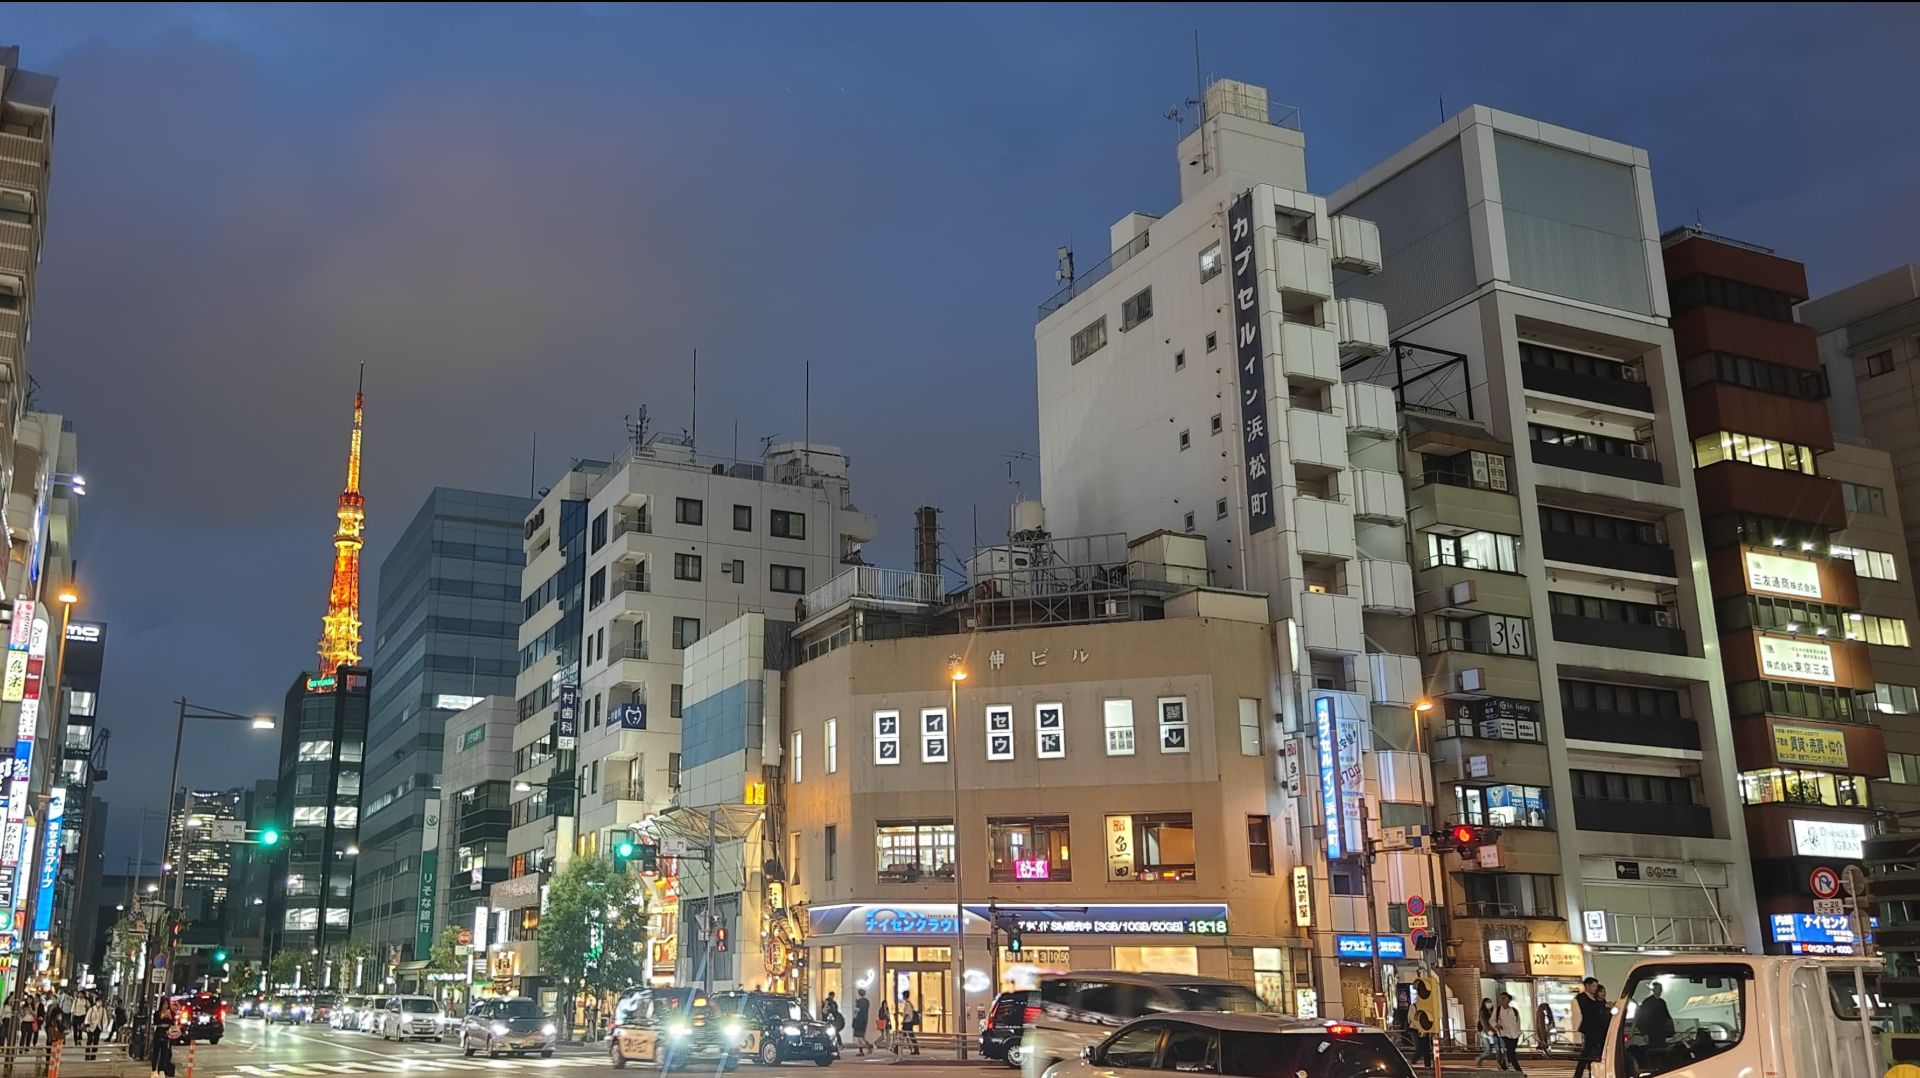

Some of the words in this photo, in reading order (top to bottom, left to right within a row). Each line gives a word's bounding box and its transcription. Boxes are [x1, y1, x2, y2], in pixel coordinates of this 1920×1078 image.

[1232, 217, 1268, 516] カプセルイン浜松町
[560, 738, 573, 748] 5F
[419, 872, 433, 933] りそな銀行
